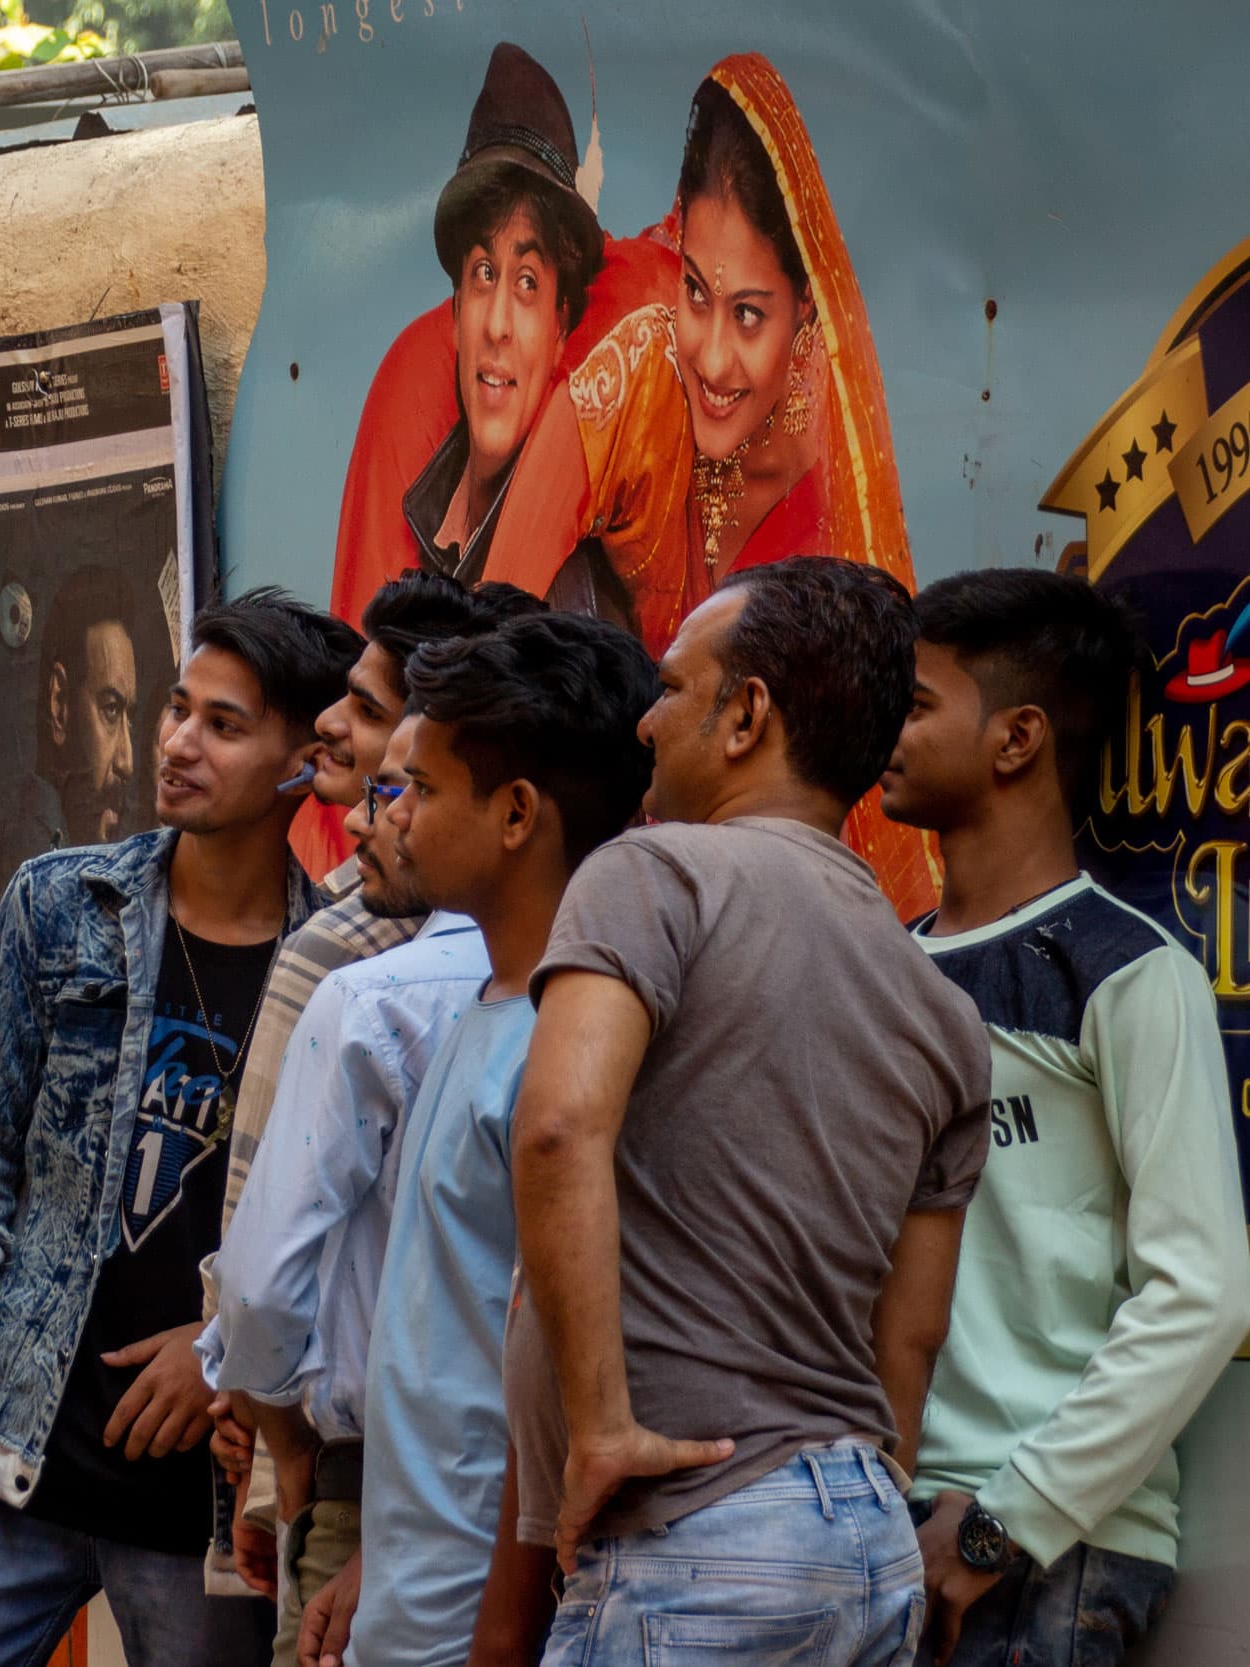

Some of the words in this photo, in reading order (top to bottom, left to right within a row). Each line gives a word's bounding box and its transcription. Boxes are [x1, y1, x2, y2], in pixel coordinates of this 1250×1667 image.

[260, 0, 463, 45] longes
[1195, 411, 1250, 505] 199
[991, 1093, 1040, 1149] SN
